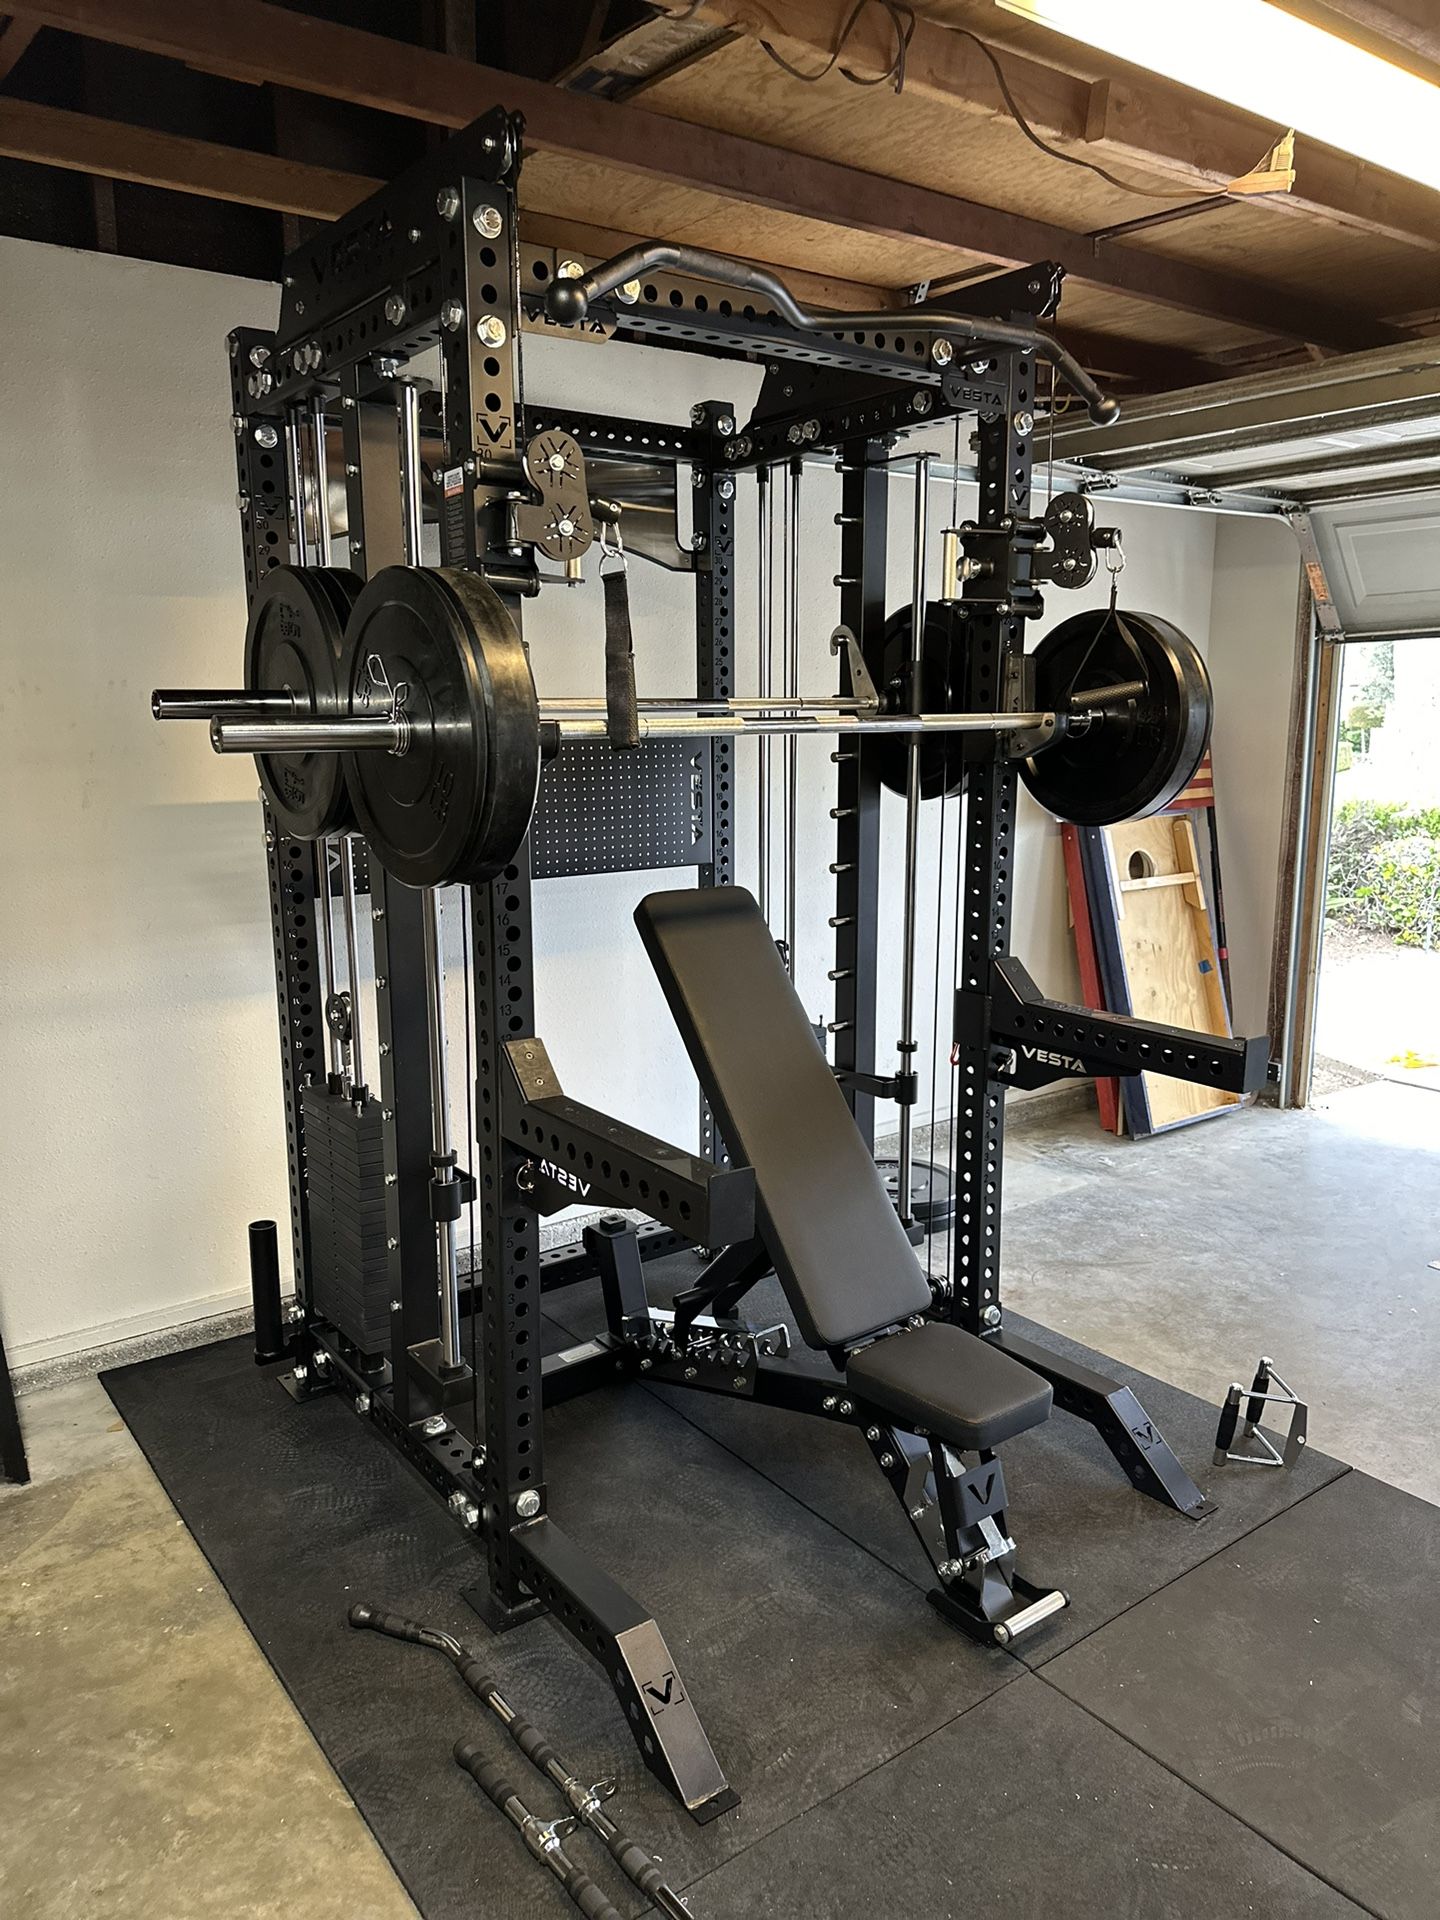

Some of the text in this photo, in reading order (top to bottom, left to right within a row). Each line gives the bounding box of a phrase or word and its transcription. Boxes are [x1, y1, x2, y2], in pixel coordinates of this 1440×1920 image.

[522, 305, 607, 335] VETA
[950, 384, 1002, 406] VESTA
[479, 419, 508, 443] V
[256, 520, 269, 530] 30
[258, 545, 270, 555] 29
[715, 577, 722, 585] 29
[715, 598, 723, 606] 28
[715, 618, 723, 626] 27
[715, 638, 723, 646] 26
[715, 658, 723, 666] 25
[715, 678, 724, 686] 24
[716, 755, 723, 763] 20
[495, 883, 508, 895] 17
[497, 914, 510, 926] 16
[498, 944, 511, 956] 15
[499, 974, 512, 986] 14
[500, 1004, 512, 1016] 13
[1021, 1044, 1087, 1074] VESTA
[506, 1237, 514, 1248] 5
[507, 1265, 515, 1276] 4
[508, 1293, 515, 1304] 3
[508, 1321, 516, 1332] 2
[967, 1472, 996, 1505] V
